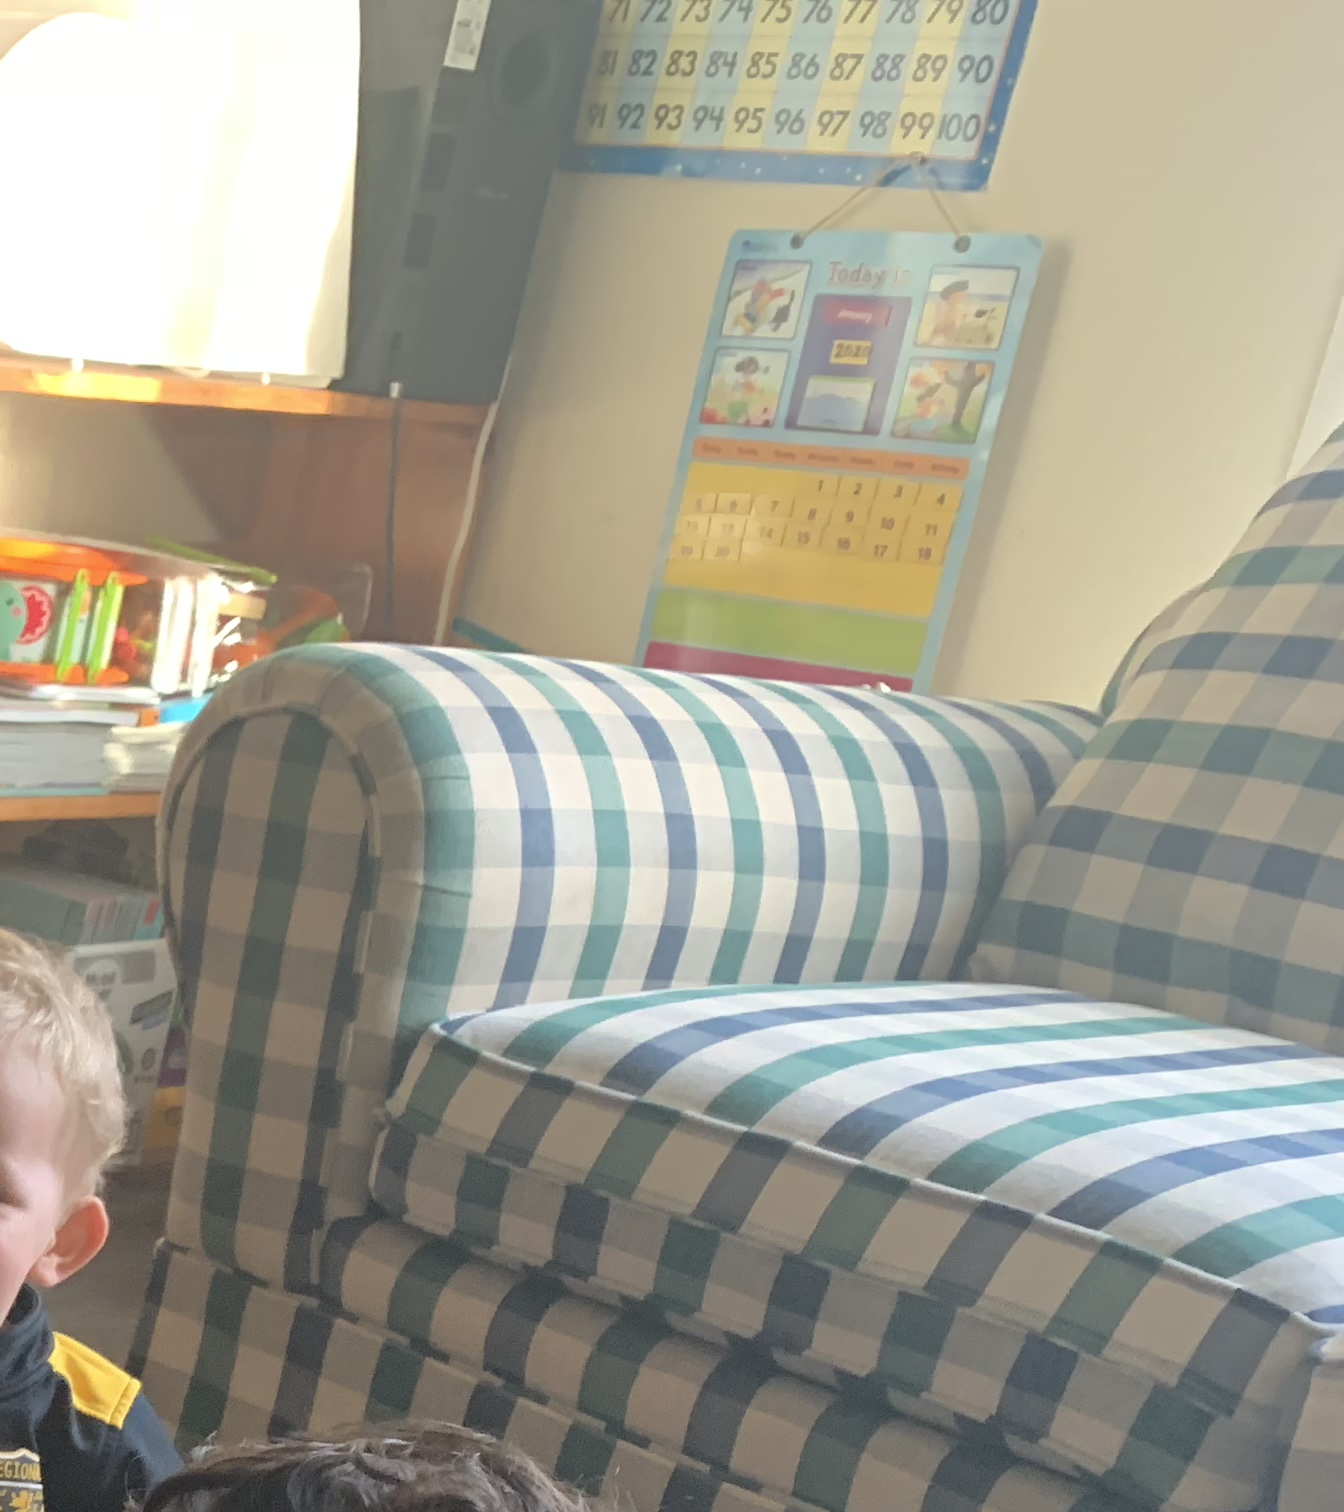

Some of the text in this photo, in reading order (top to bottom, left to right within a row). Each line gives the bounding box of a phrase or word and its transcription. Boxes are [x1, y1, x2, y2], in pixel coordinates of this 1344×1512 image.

[597, 49, 994, 84] 81 82 83 84 85 86 87 88 89 90
[588, 103, 981, 142] 91 92 93 94 95 96 97 98 99 100
[828, 261, 887, 290] Today
[852, 482, 863, 496] 2
[892, 484, 904, 499] 3
[935, 492, 947, 506] 4
[770, 499, 780, 513] 7
[924, 522, 939, 537] 11
